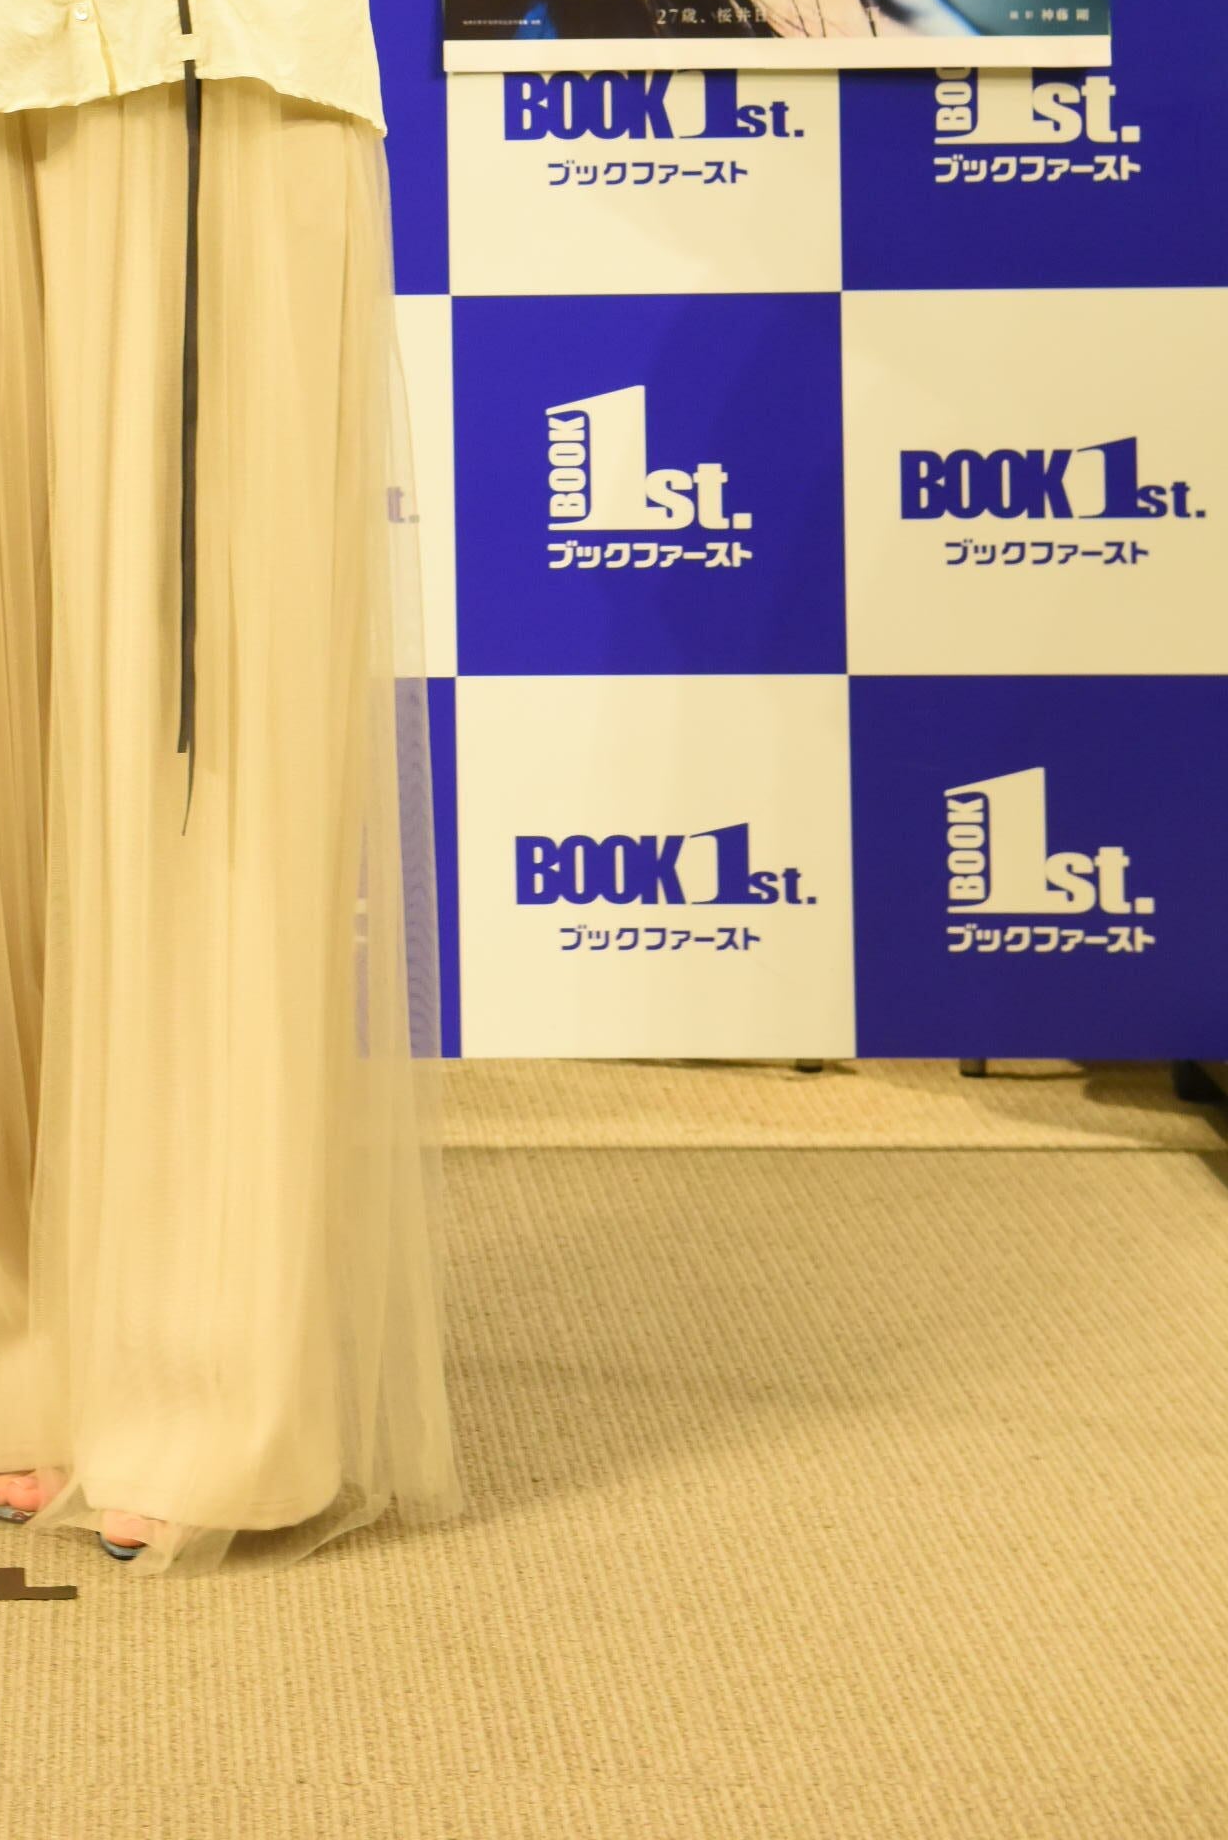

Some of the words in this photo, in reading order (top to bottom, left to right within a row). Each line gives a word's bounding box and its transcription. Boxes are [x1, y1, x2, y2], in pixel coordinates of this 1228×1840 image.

[547, 161, 748, 187] ブックファースト
[933, 155, 1141, 184] ブックファースト
[547, 542, 753, 570] ブックファースト
[946, 543, 1148, 566] ブックファースト
[560, 928, 760, 952] ブックファースト
[946, 924, 1157, 954] ブックファースト
